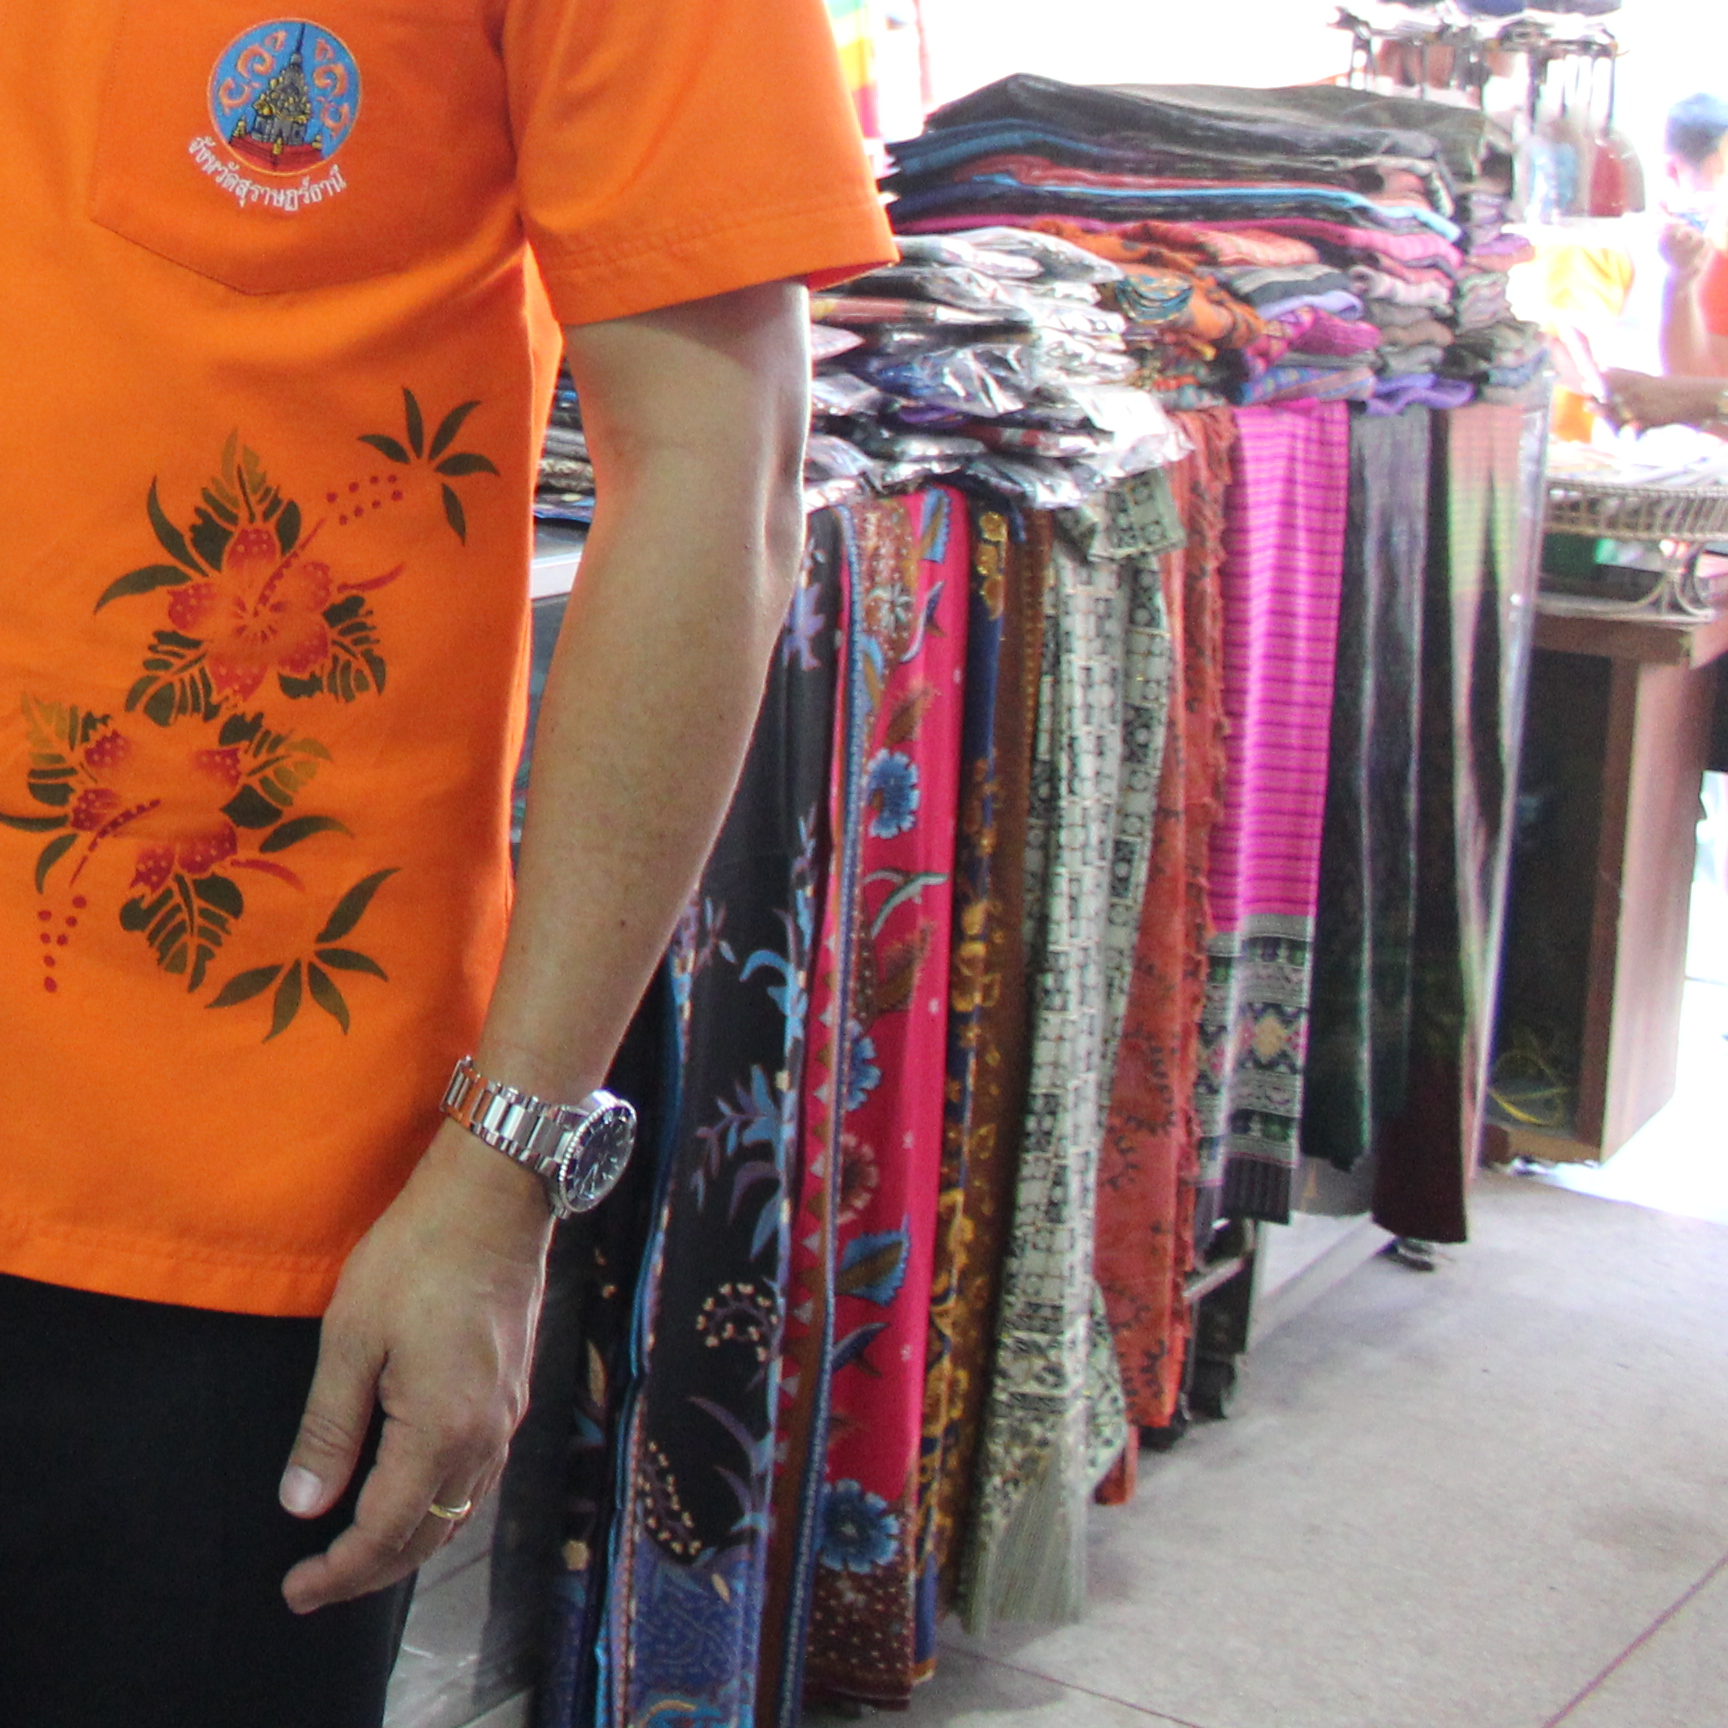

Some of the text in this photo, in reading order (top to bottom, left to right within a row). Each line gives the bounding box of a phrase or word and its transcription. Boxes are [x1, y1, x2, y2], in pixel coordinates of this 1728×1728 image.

[187, 135, 347, 212] จังหวัดสุราษฎร์ธานี
